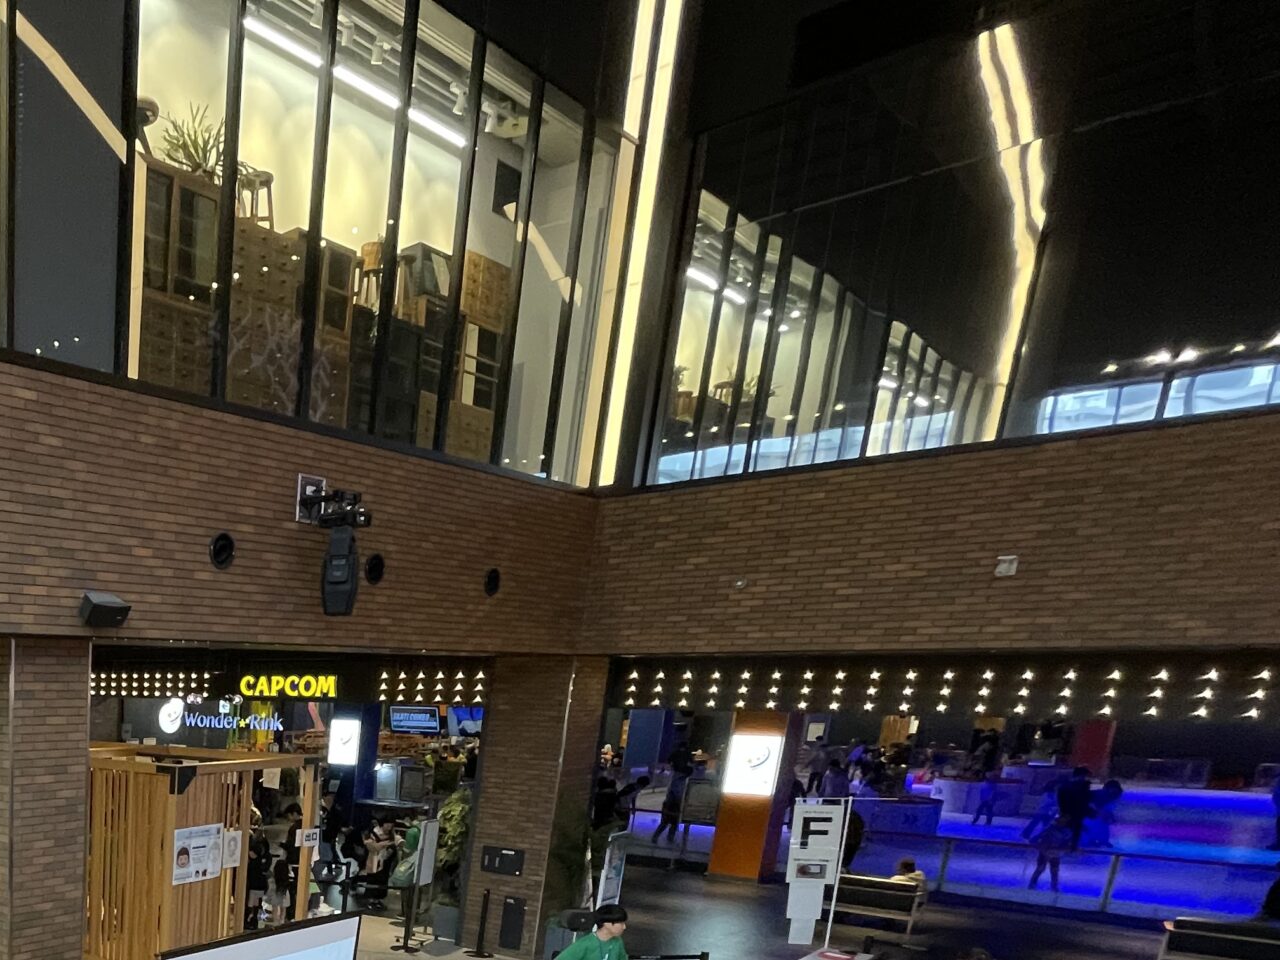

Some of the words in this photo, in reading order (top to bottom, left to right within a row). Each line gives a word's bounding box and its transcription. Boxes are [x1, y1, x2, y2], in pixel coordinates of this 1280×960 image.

[239, 675, 336, 698] CAPCOM
[184, 711, 239, 729] Wonder
[248, 712, 284, 731] Rink
[800, 816, 833, 849] F
